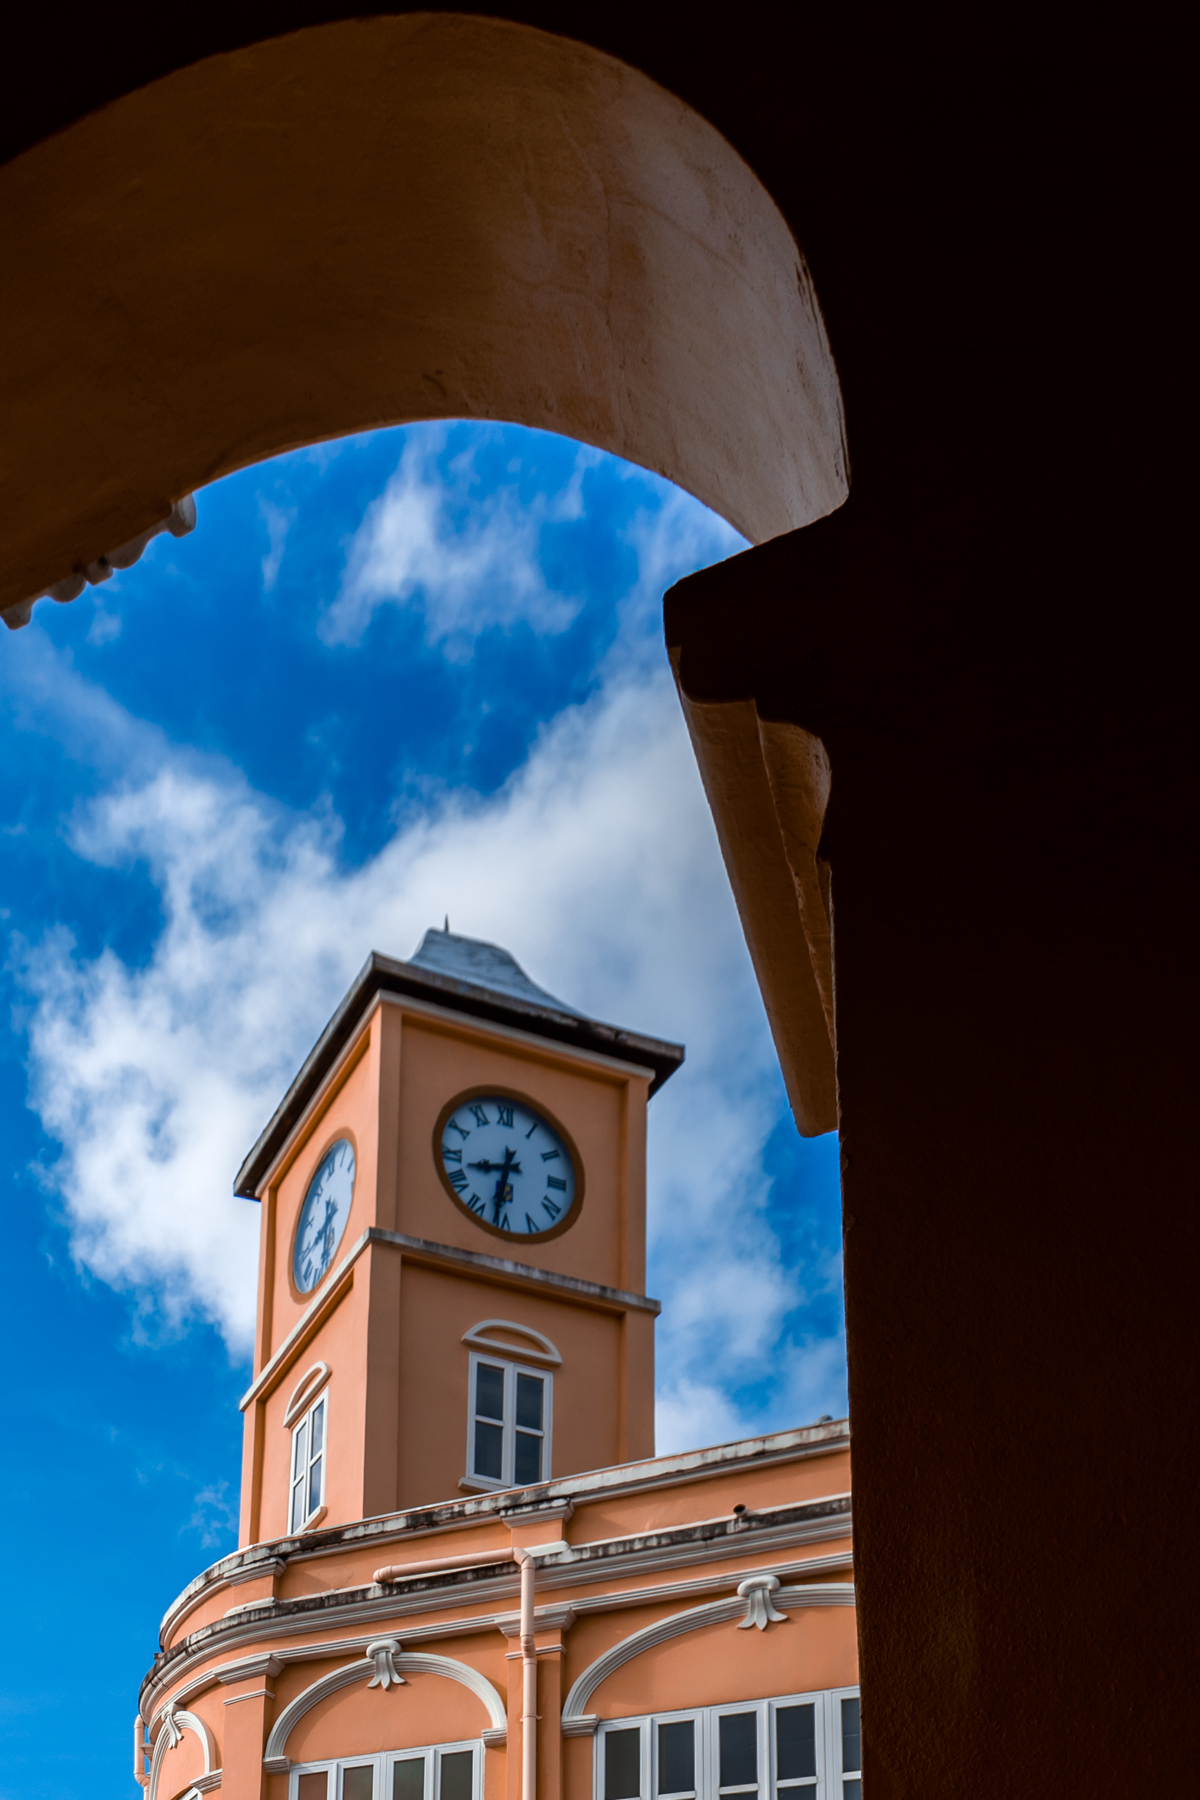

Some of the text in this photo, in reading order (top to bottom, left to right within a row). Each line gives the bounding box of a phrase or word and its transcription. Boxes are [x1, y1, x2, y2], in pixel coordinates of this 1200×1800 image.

[496, 1104, 514, 1128] XII
[448, 1118, 470, 1140] X
[541, 1148, 561, 1162] II
